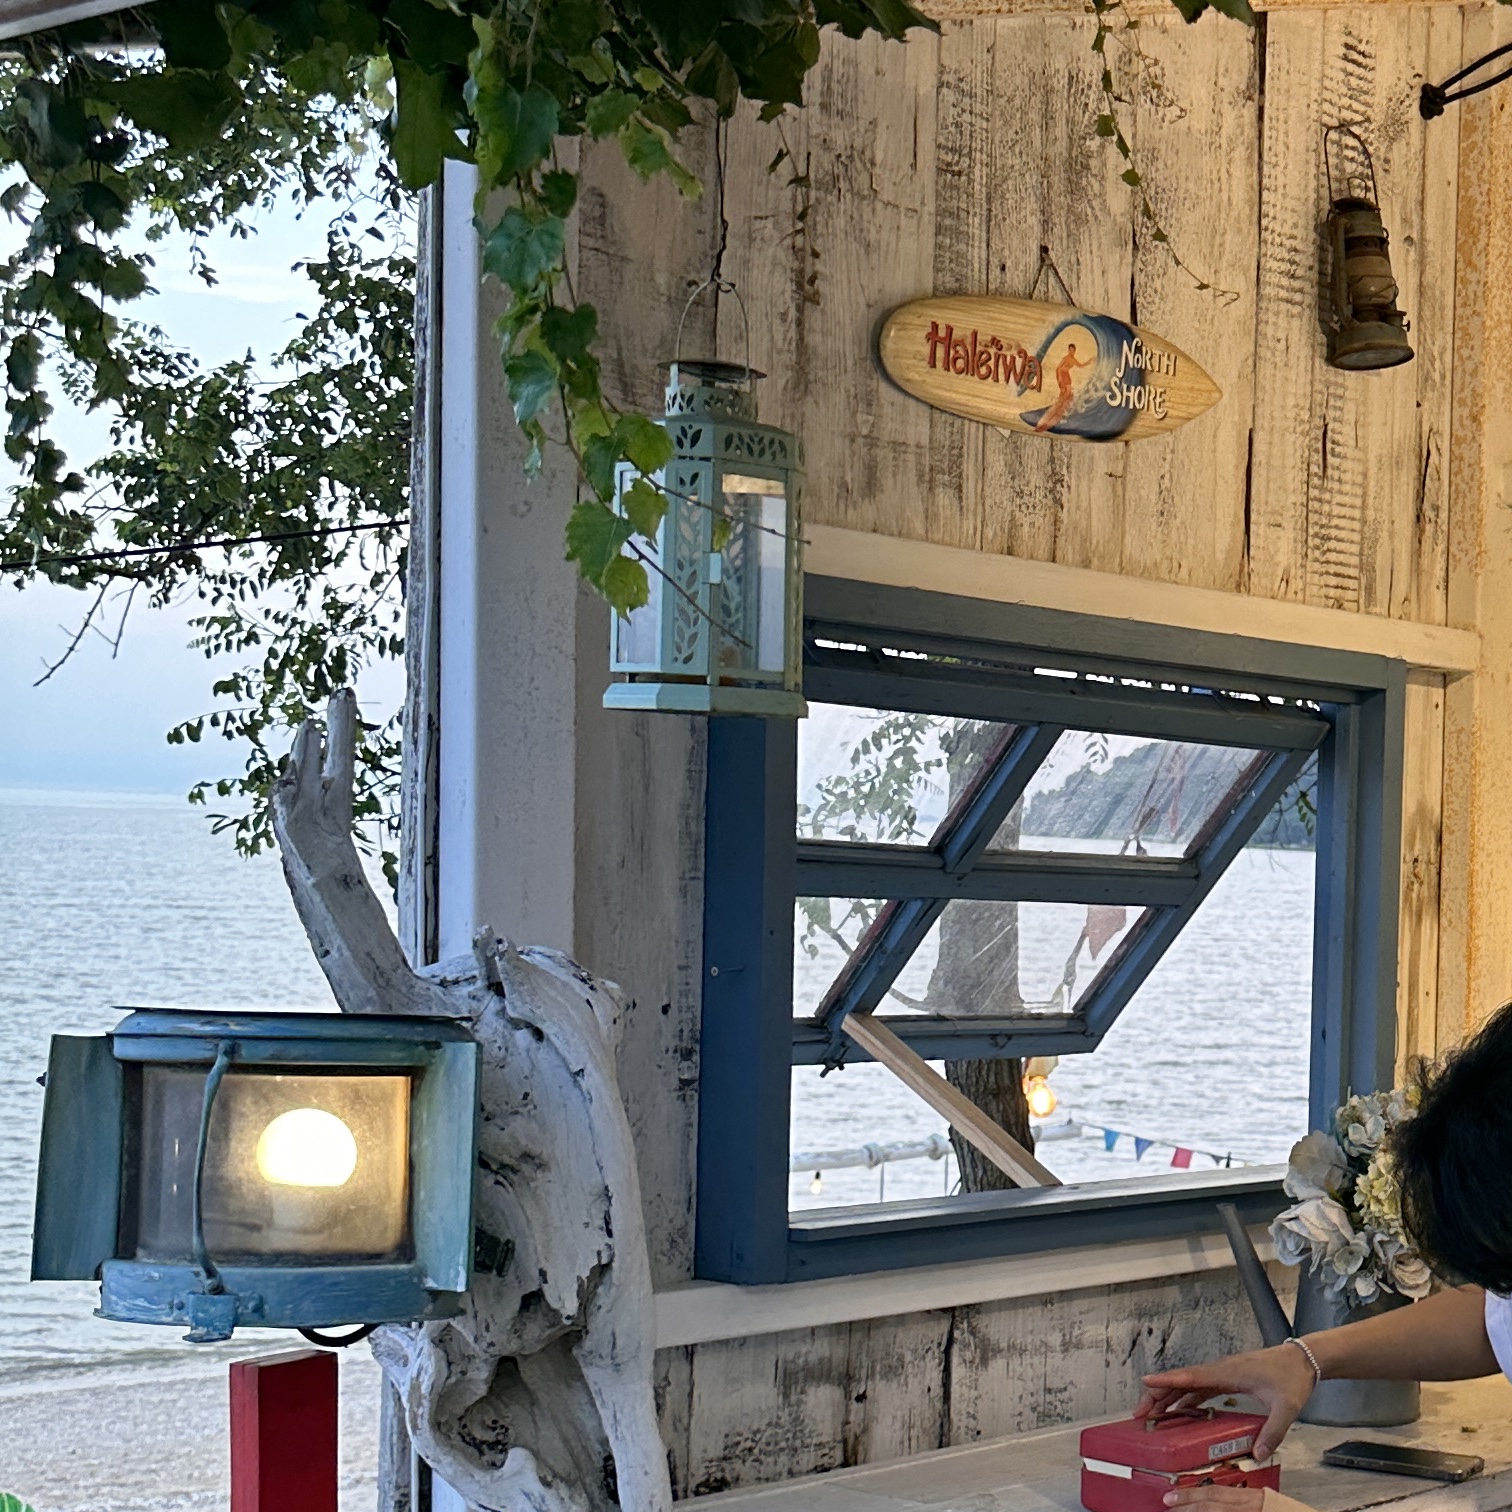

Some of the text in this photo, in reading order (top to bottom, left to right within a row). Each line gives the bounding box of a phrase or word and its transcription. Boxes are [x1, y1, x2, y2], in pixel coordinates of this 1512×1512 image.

[926, 321, 1042, 393] Haleiwa
[1116, 338, 1177, 378] NORTH
[1106, 379, 1168, 420] SHORE
